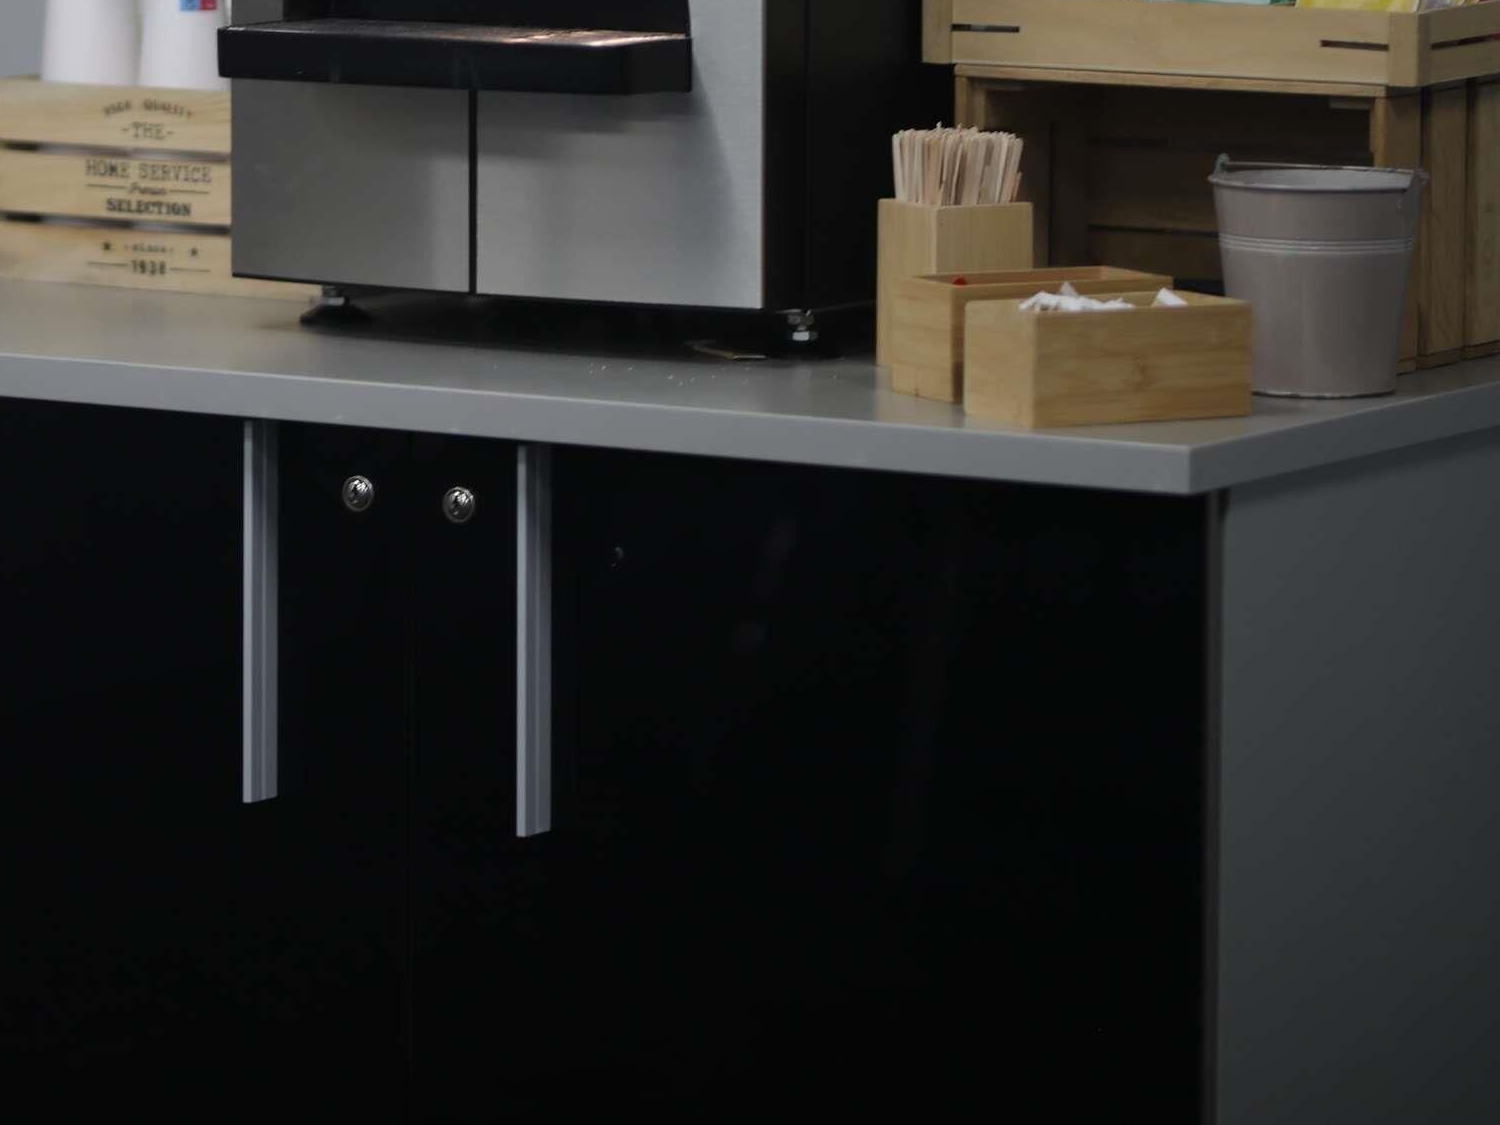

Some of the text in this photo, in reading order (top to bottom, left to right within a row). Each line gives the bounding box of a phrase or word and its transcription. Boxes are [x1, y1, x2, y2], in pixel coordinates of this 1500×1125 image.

[142, 98, 193, 118] QUALITY
[85, 158, 212, 183] HOME SERVICE
[105, 197, 192, 216] SELECTION
